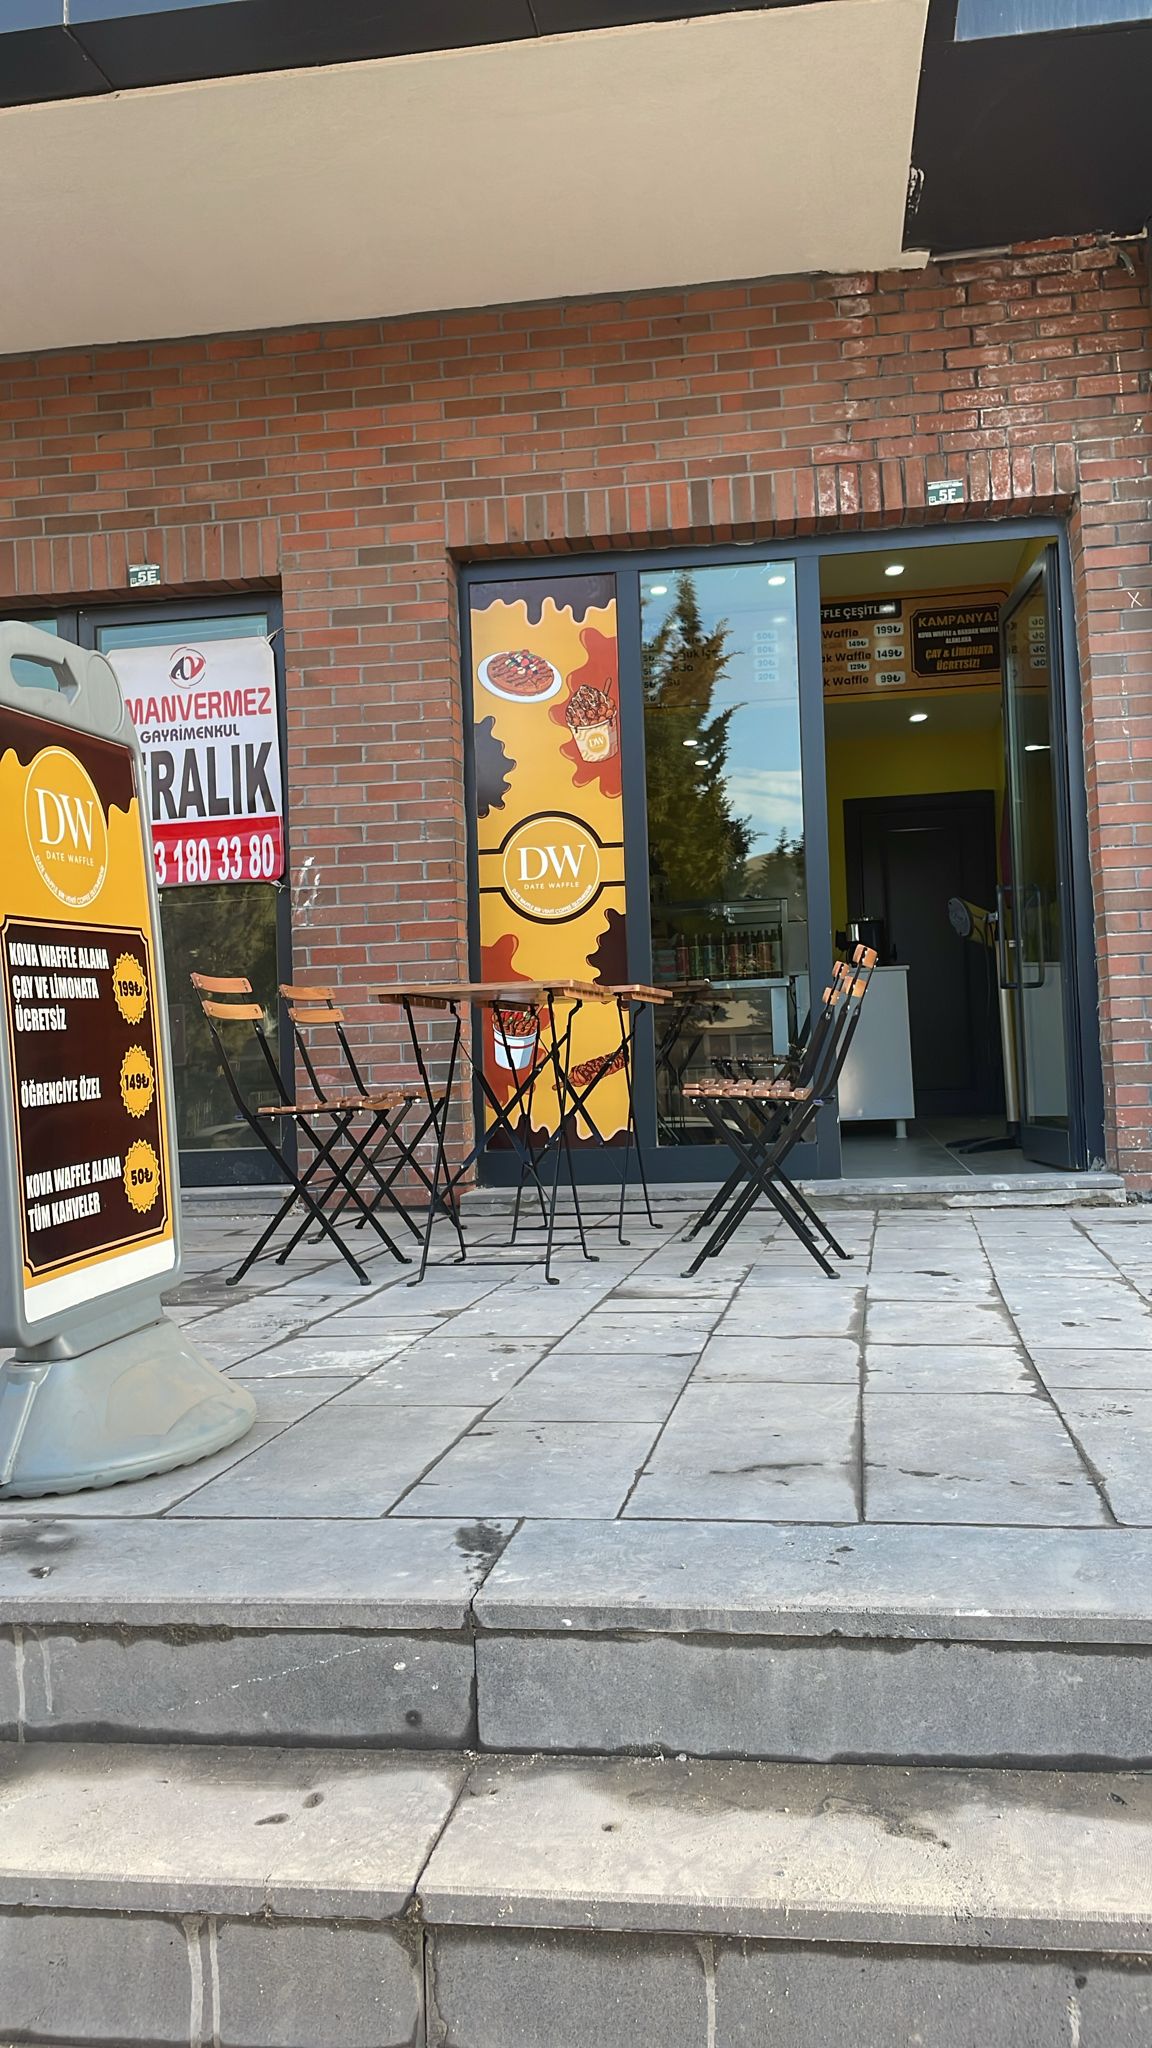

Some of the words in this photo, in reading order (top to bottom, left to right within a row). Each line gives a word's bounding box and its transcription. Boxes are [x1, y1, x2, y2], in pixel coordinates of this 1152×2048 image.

[939, 488, 957, 501] 5F
[137, 570, 157, 582] 5E
[918, 611, 998, 628] KAMPANYA!
[140, 724, 240, 743] GAYRİMENKUL
[143, 742, 276, 821] RALIK
[34, 788, 94, 852] DW
[46, 850, 65, 862] DATE
[67, 854, 95, 867] WAFFLE
[173, 838, 211, 883] 180
[217, 836, 243, 880] 33
[249, 834, 274, 879] 80
[517, 844, 587, 881] DW
[548, 881, 580, 889] WAFFLE
[9, 942, 39, 966] KOVA
[38, 945, 78, 968] WAFFLE
[78, 947, 110, 970] ALANA
[12, 975, 34, 1003] ÇAY
[34, 976, 53, 999] VE
[49, 973, 100, 999] LİMONATA
[118, 981, 143, 997] 199₺
[15, 1004, 67, 1032] ÜCRETSİZ
[21, 1077, 78, 1108] ÖĞRENCİYE
[79, 1075, 101, 1100] ÖZEL
[125, 1073, 149, 1091] 149₺
[26, 1171, 54, 1199] KOVA
[53, 1162, 91, 1192] WAFFLE
[92, 1156, 122, 1183] ALANA
[131, 1168, 153, 1186] 50₺
[28, 1203, 51, 1232] TÜM
[51, 1192, 101, 1226] KAHVELER
